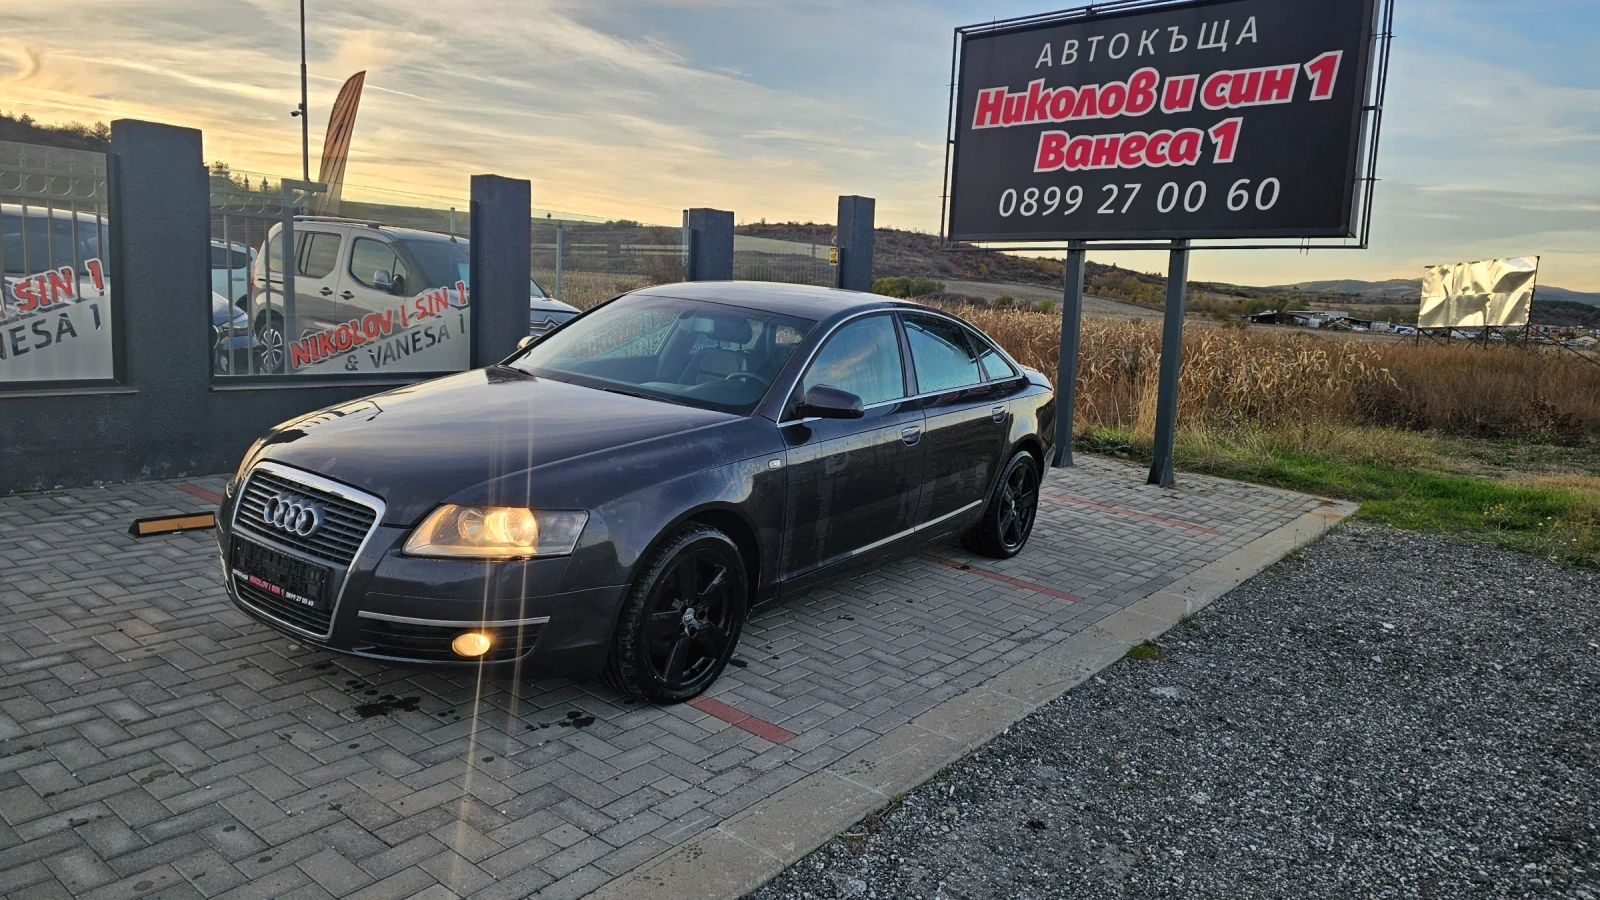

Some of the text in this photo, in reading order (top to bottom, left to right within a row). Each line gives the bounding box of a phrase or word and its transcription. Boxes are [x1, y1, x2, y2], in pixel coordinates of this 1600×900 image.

[1036, 16, 1258, 69] АВТОКЪЩА
[971, 50, 1344, 130] Николов и син 1
[1033, 116, 1243, 173] Ванеса 1
[999, 177, 1281, 217] 0899 27 00 60
[11, 265, 78, 316] SIN
[89, 303, 102, 330] 1
[290, 309, 394, 369] NIKOLOV
[414, 286, 450, 322] SIN
[345, 354, 359, 372] &
[368, 321, 451, 370] VANESA
